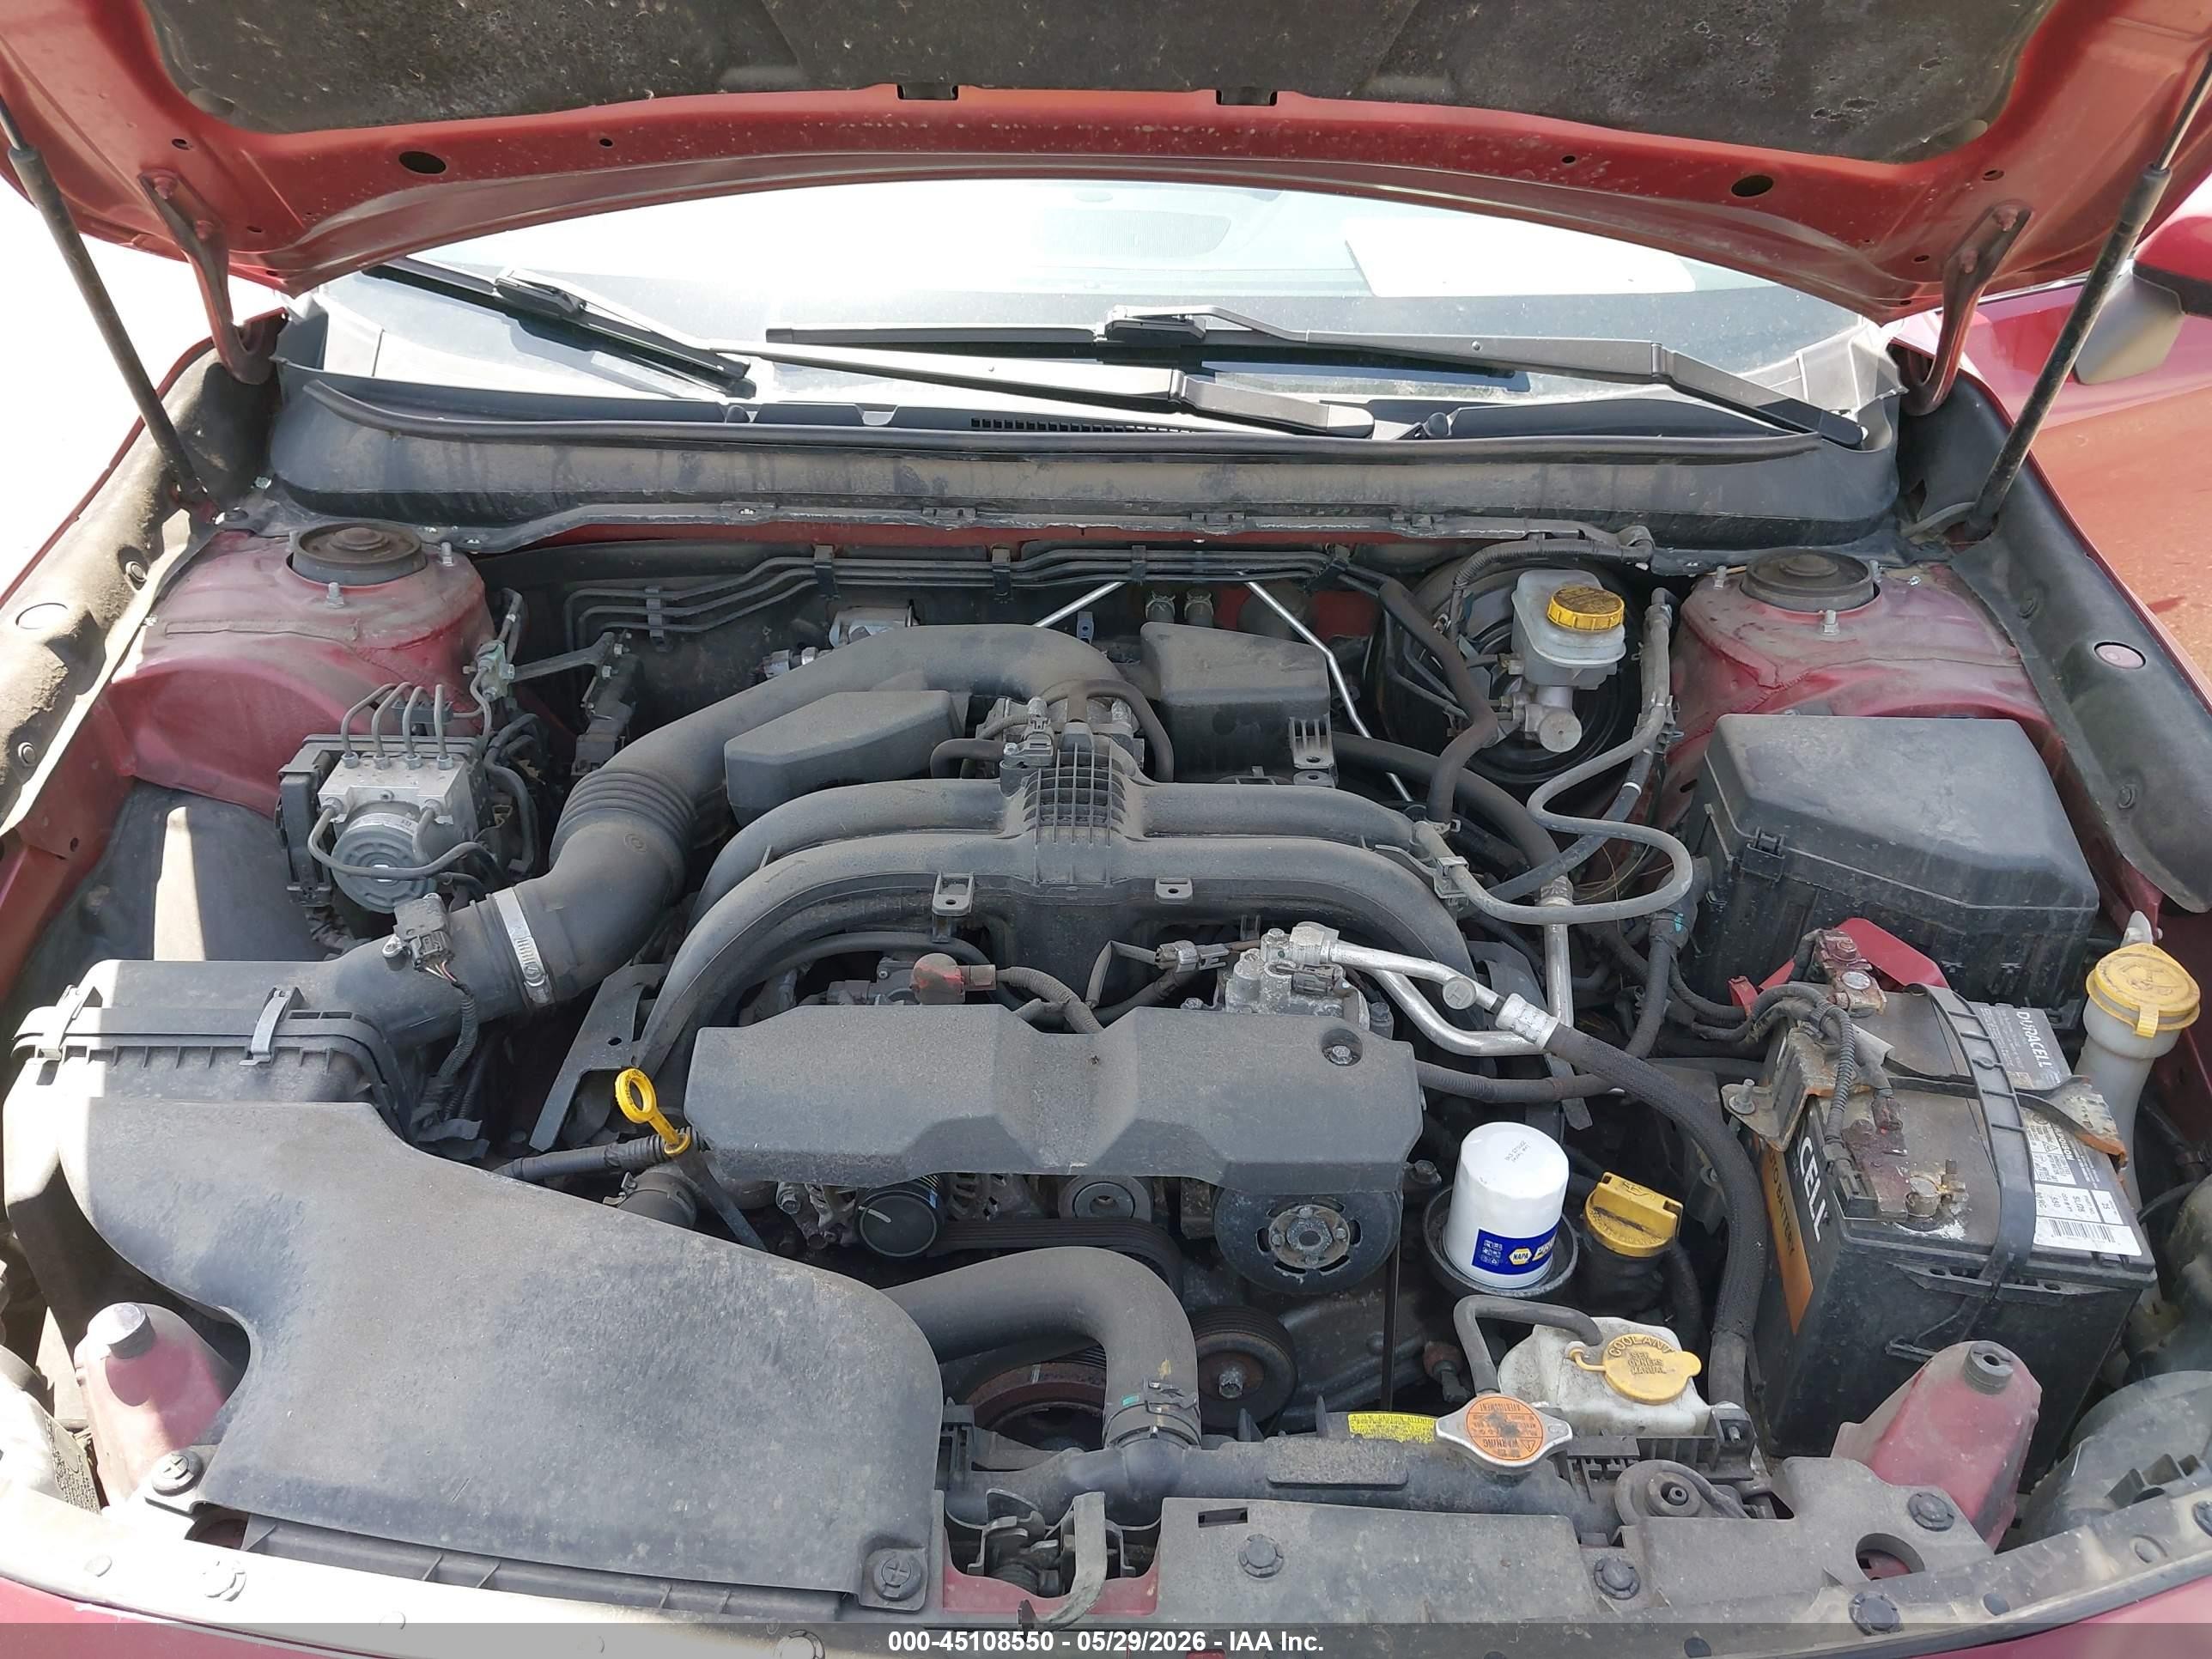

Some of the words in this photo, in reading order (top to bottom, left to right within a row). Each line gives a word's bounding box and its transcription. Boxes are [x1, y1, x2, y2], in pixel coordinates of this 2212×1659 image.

[2015, 1011, 2052, 1068] DURACELL
[1776, 1183, 1796, 1257] BATTERY
[1512, 1252, 1529, 1261] NAPA
[1608, 1336, 1675, 1358] COOLANT
